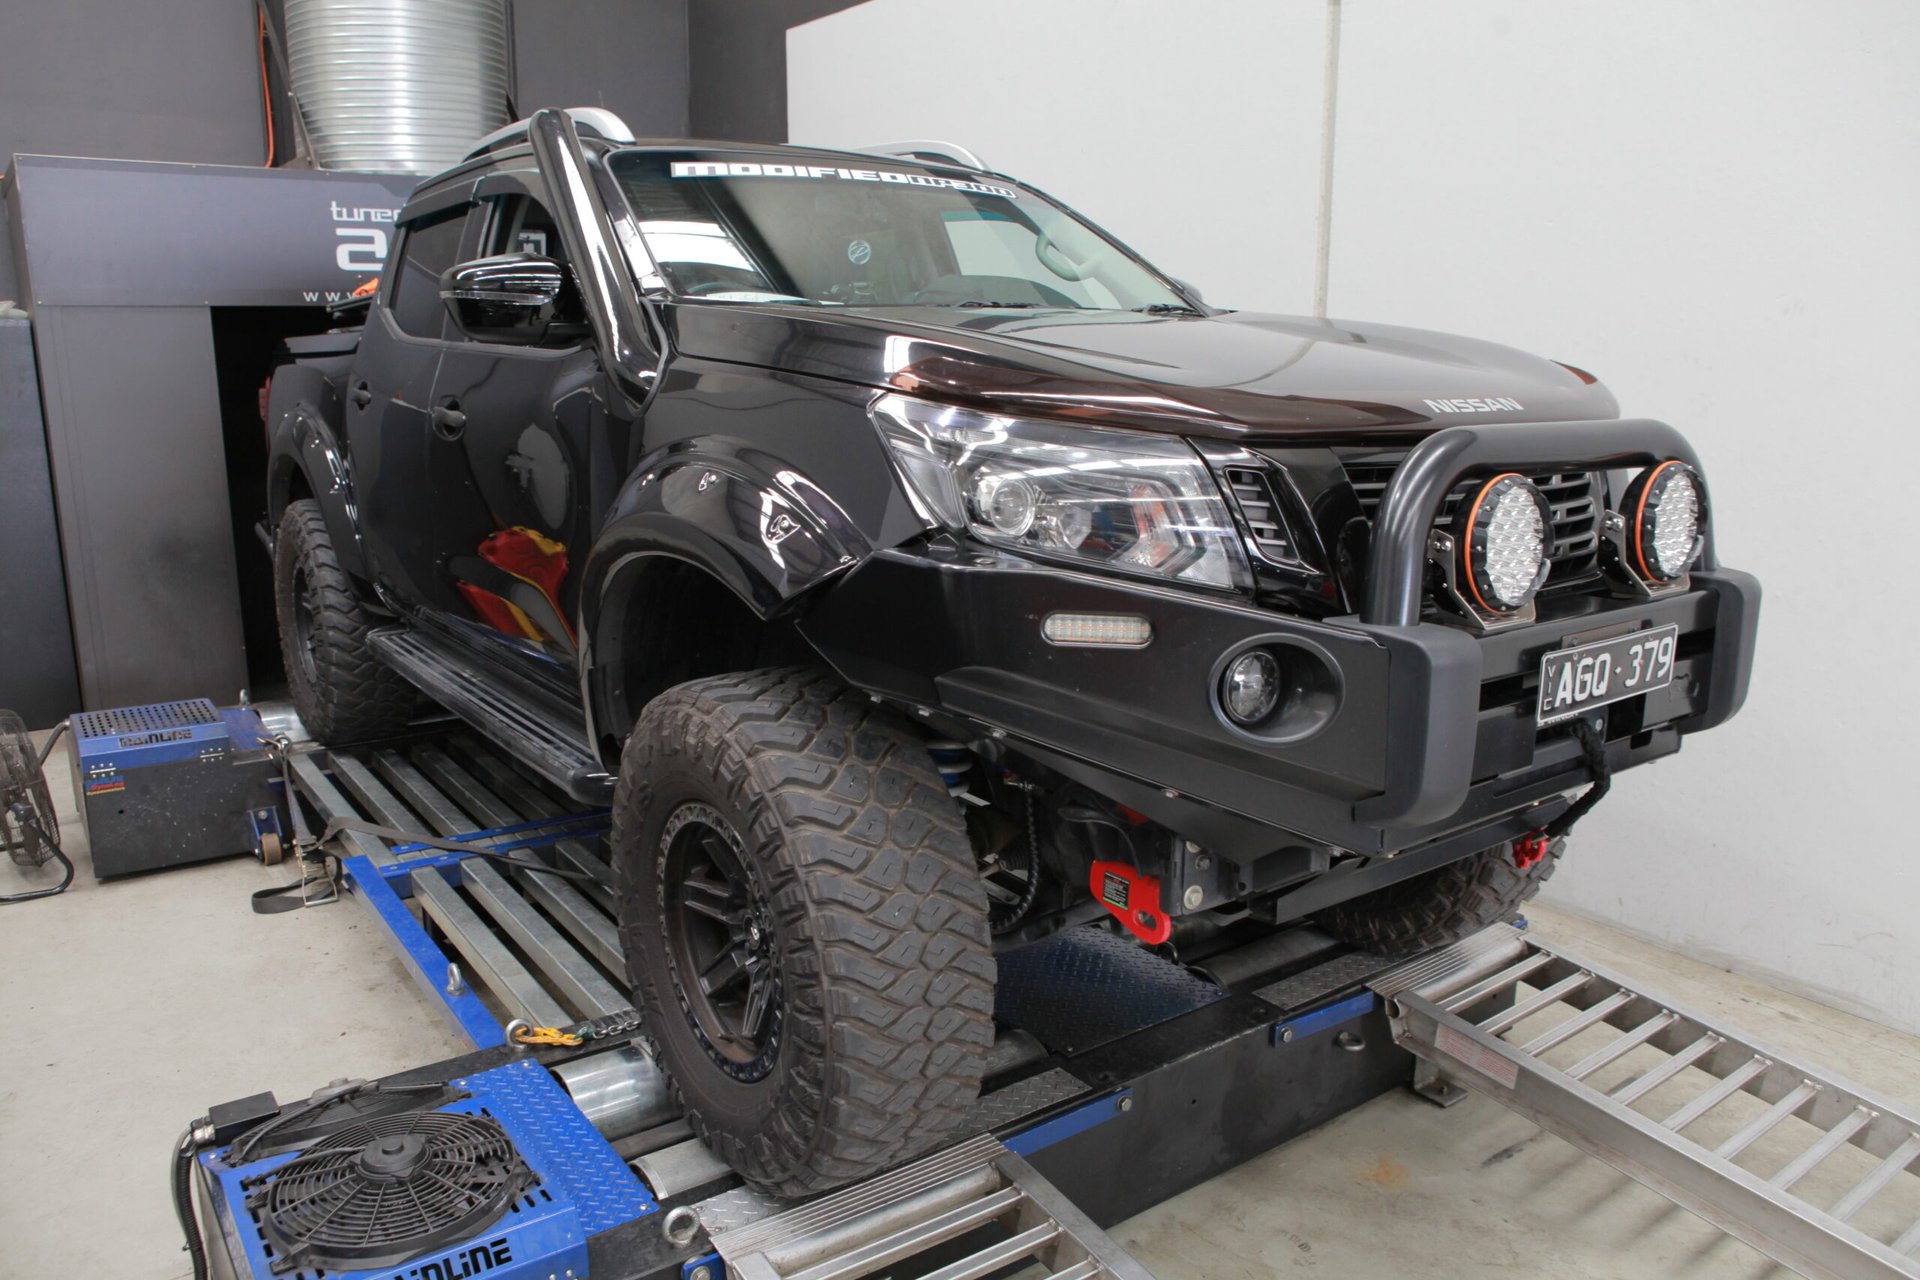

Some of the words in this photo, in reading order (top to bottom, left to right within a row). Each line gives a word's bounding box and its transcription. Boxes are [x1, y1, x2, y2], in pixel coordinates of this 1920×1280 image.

[1423, 397, 1525, 413] NISSAN
[1553, 652, 1611, 707] AGQ
[1624, 636, 1673, 687] 379
[393, 1236, 513, 1280] NLINE
